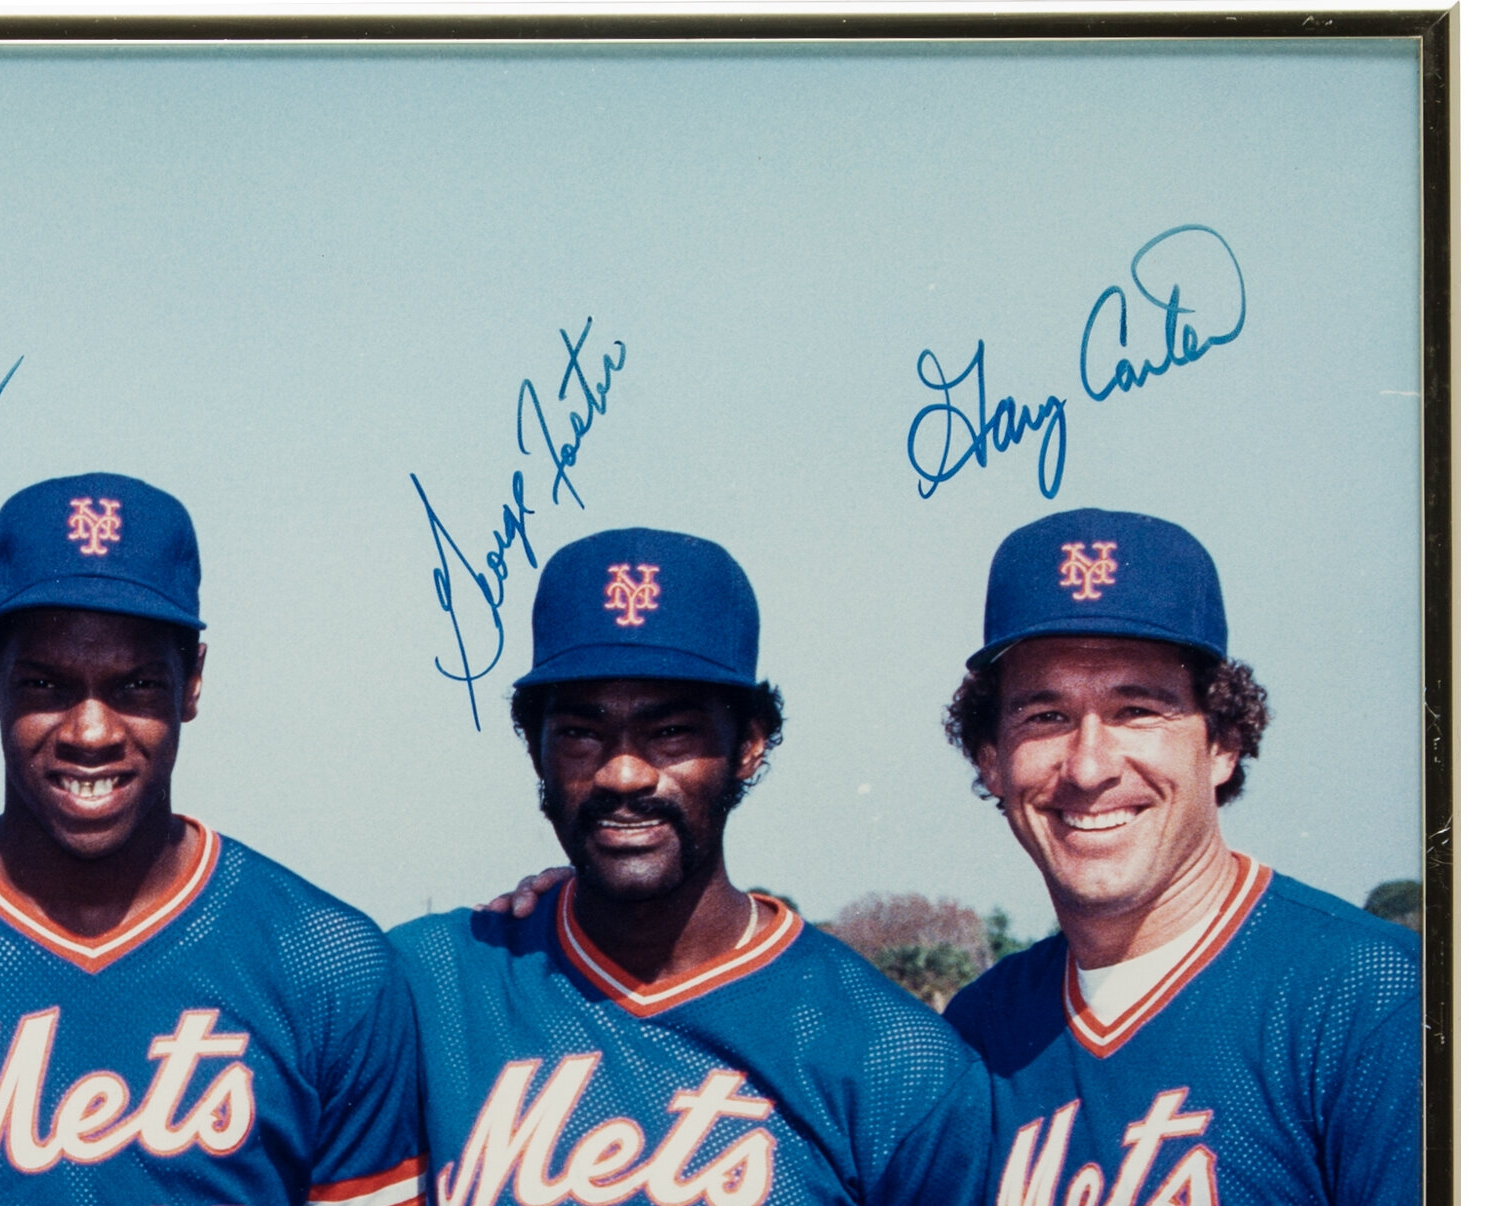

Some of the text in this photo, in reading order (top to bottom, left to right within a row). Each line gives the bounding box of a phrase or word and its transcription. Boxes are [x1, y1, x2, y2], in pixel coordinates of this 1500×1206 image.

[907, 224, 1246, 499] Gary Carter
[410, 472, 538, 732] George
